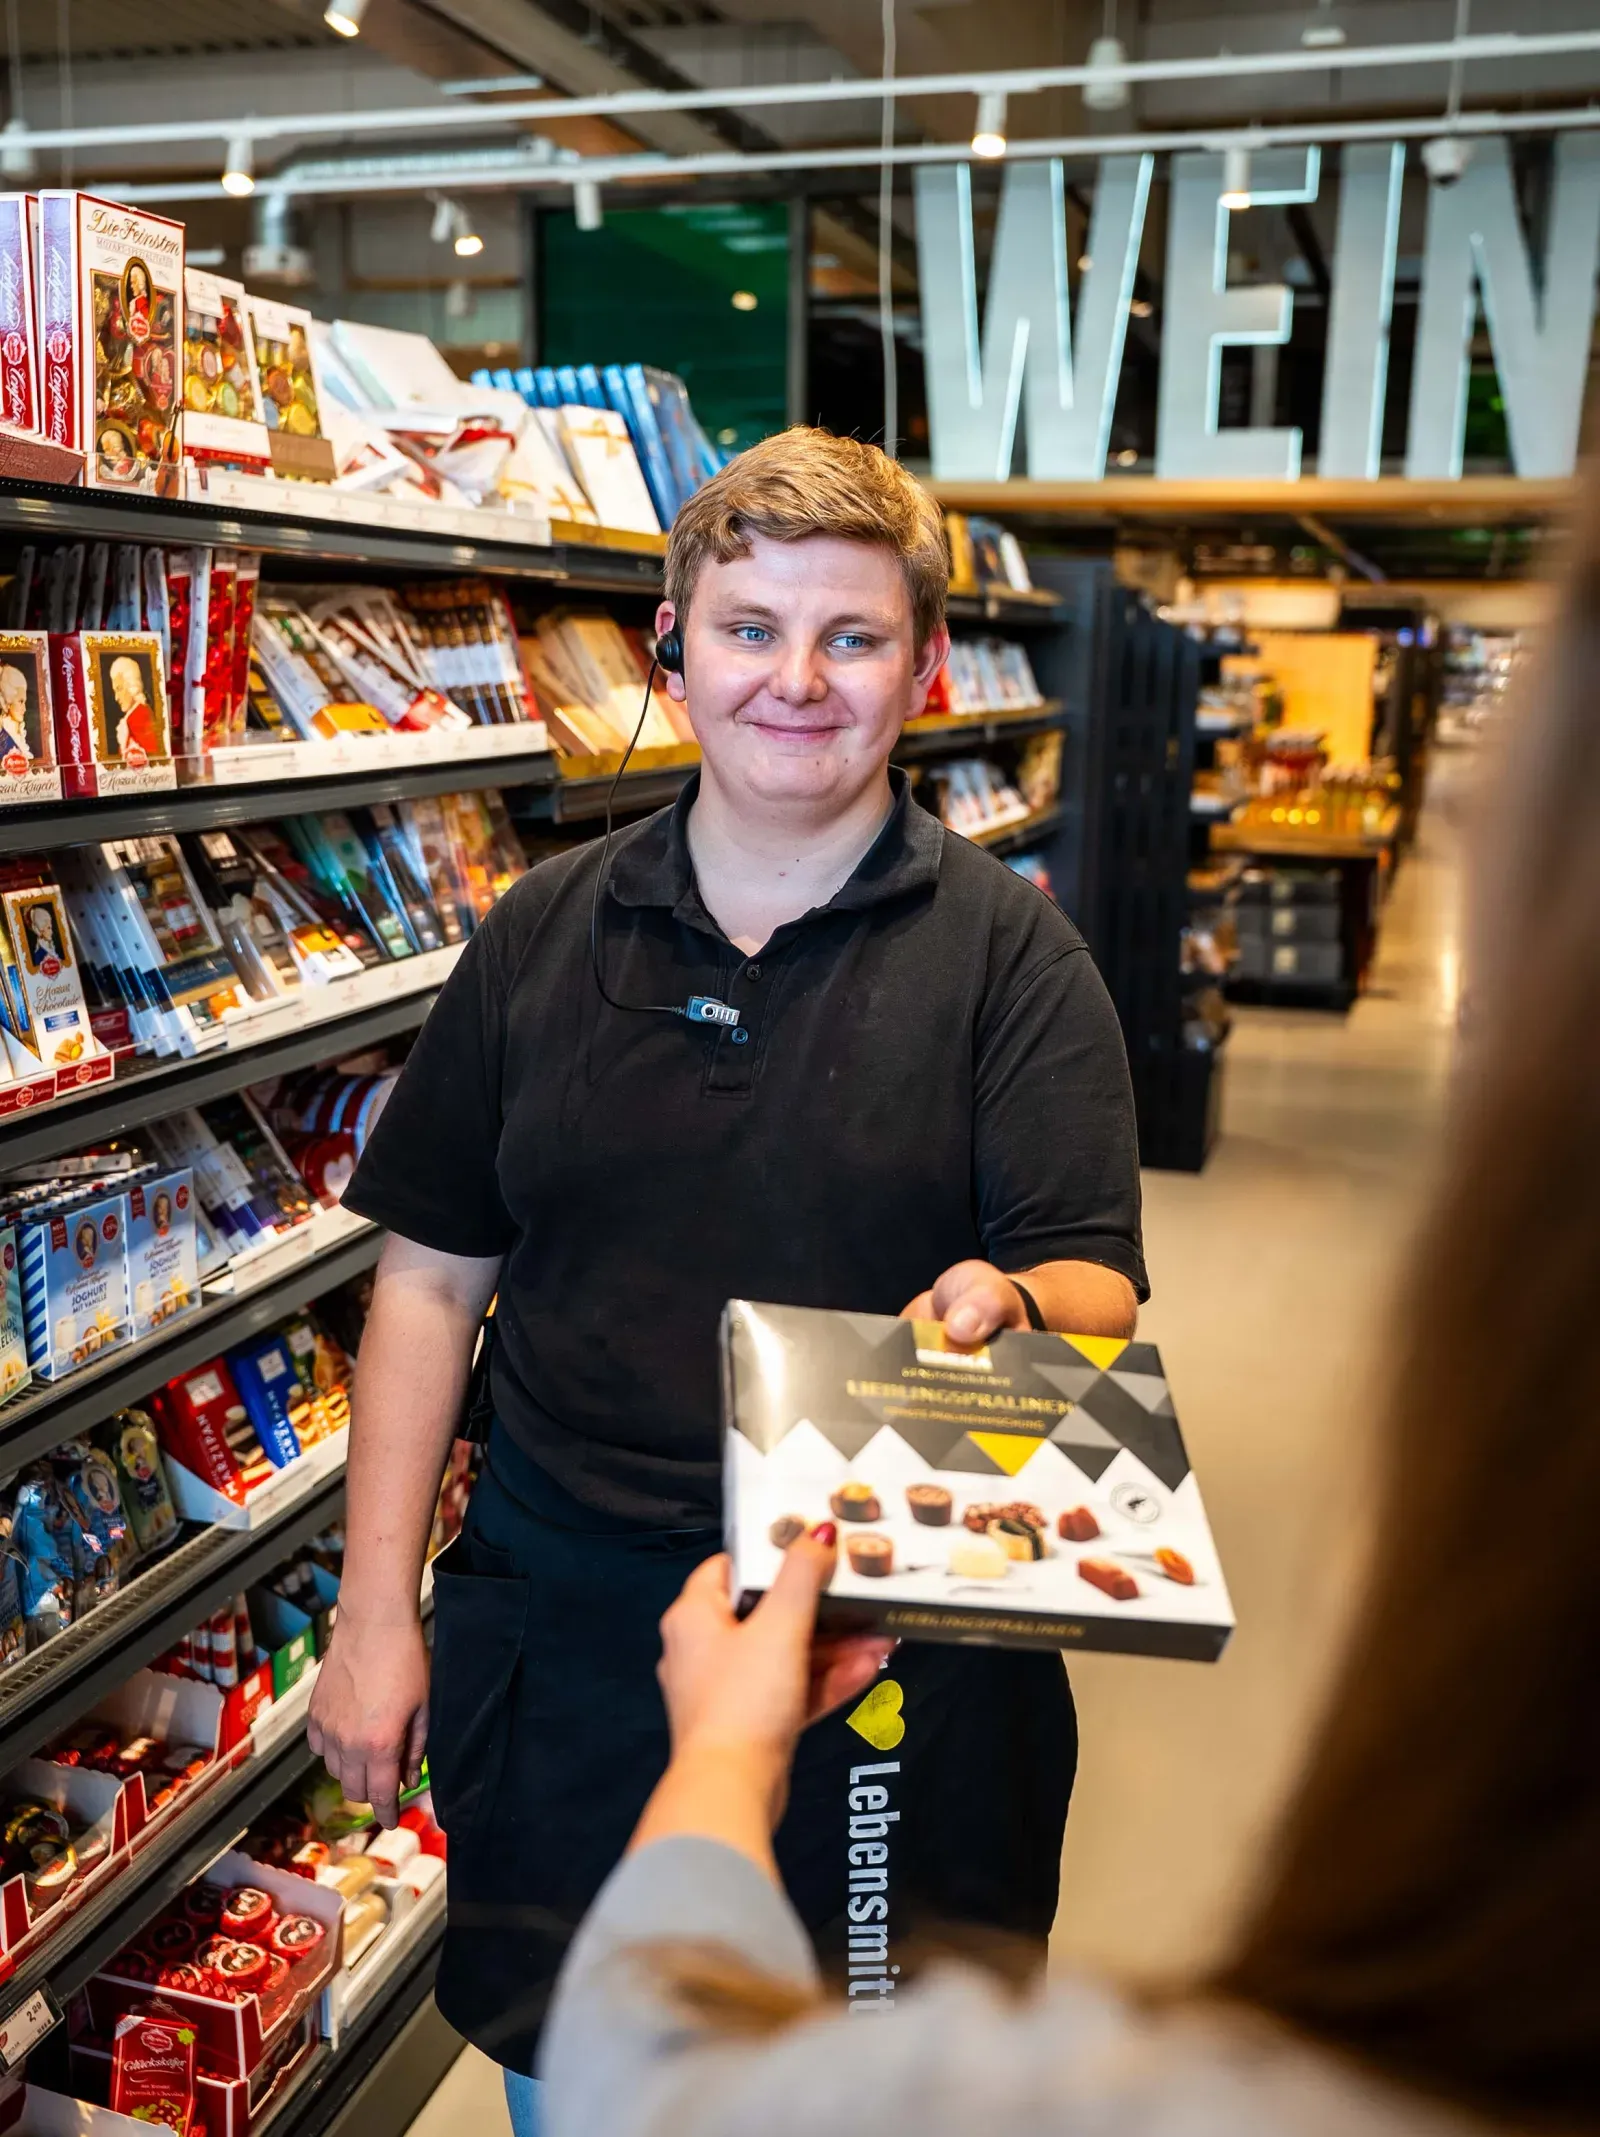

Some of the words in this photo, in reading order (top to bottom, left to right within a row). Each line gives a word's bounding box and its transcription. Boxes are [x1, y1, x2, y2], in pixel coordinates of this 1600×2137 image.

[86, 209, 120, 238] Die
[120, 217, 180, 257] Feinsten
[914, 133, 1600, 482] WEIN
[72, 1282, 108, 1306] JOGHURT
[73, 1303, 84, 1314] MIT
[0, 1328, 18, 1350] ELLO
[846, 1379, 1076, 1415] LIEBLINGSPRALINEN
[266, 1390, 297, 1457] ARZIPAN
[196, 1413, 238, 1498] MARZIPAN
[847, 1761, 901, 2013] Lebensmitt
